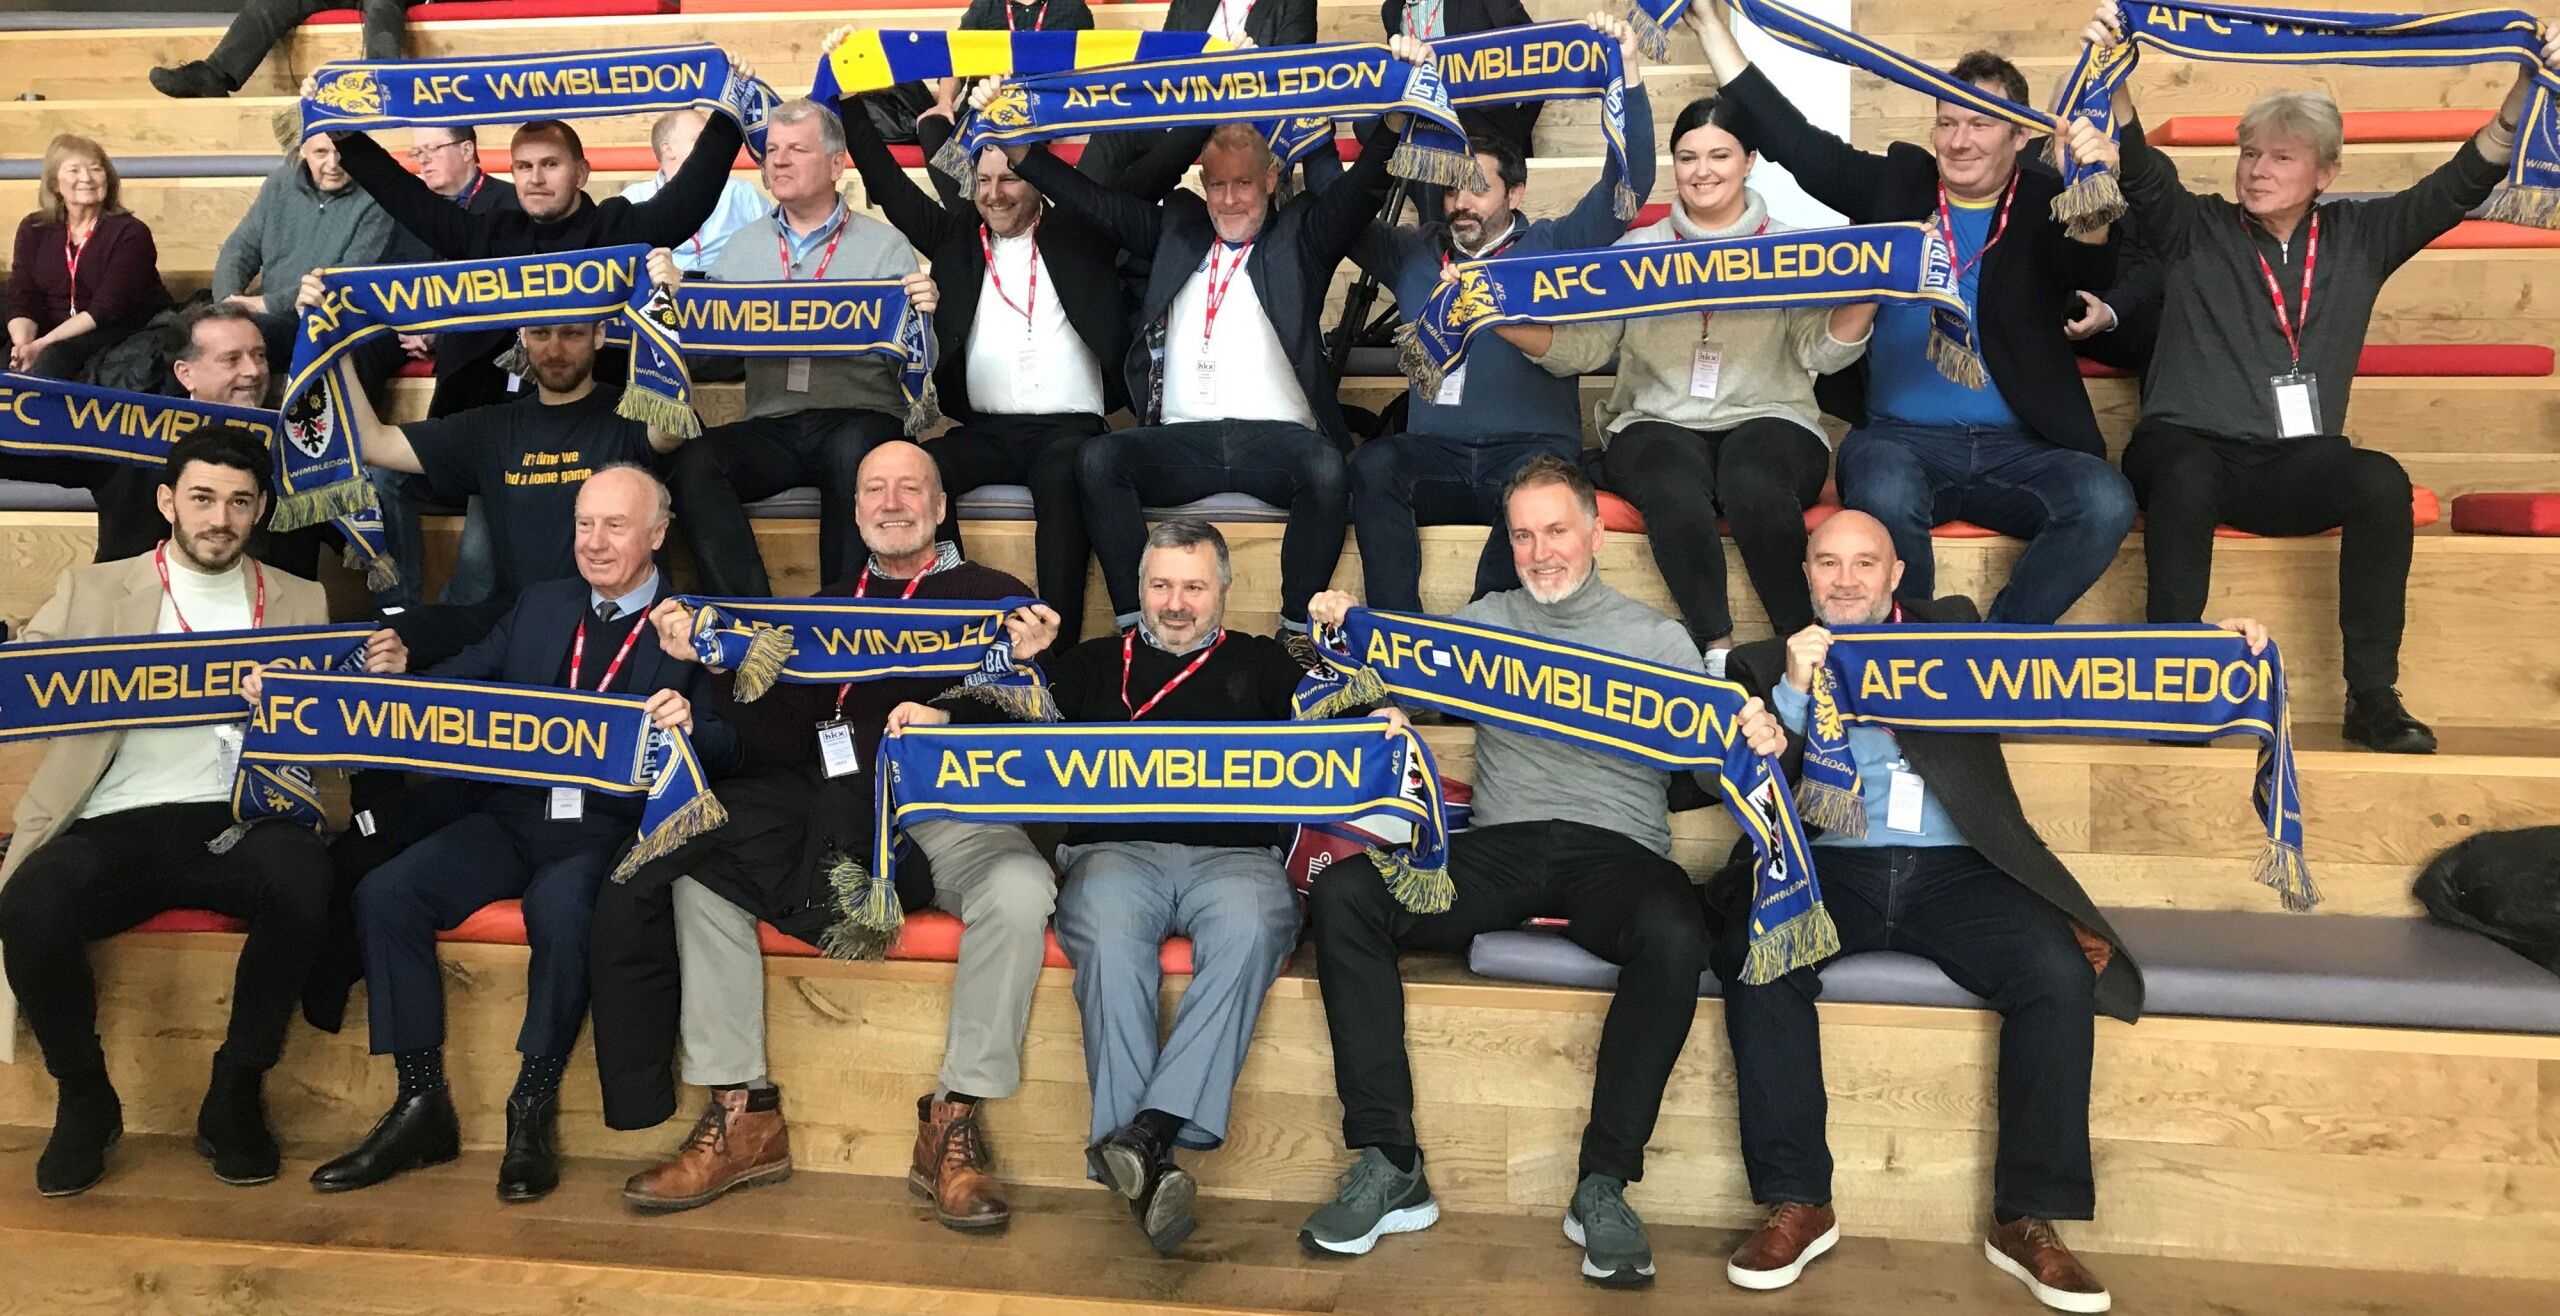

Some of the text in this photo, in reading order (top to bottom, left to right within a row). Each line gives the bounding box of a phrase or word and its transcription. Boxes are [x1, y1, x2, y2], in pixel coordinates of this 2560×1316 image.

[412, 75, 474, 105] AFC
[484, 61, 707, 99] WIMBLEDON
[1063, 60, 1387, 109] AFC WIMBLEDON
[1532, 241, 1892, 303] AFC WIMBLEDON
[305, 257, 637, 343] AFC WIMBLEDON
[677, 298, 882, 332] WIMBLEDON
[0, 388, 40, 427] FC
[561, 468, 592, 485] game
[562, 451, 579, 463] we
[1365, 628, 1740, 749] AFC WIMBLEDON
[1860, 657, 1947, 701] AFC
[250, 695, 608, 760] AFC WIMBLEDON
[890, 760, 901, 784] AFC
[936, 747, 1362, 789] AFC WIMBLEDON
[1391, 750, 1401, 775] AFC
[1755, 758, 1769, 777] AF
